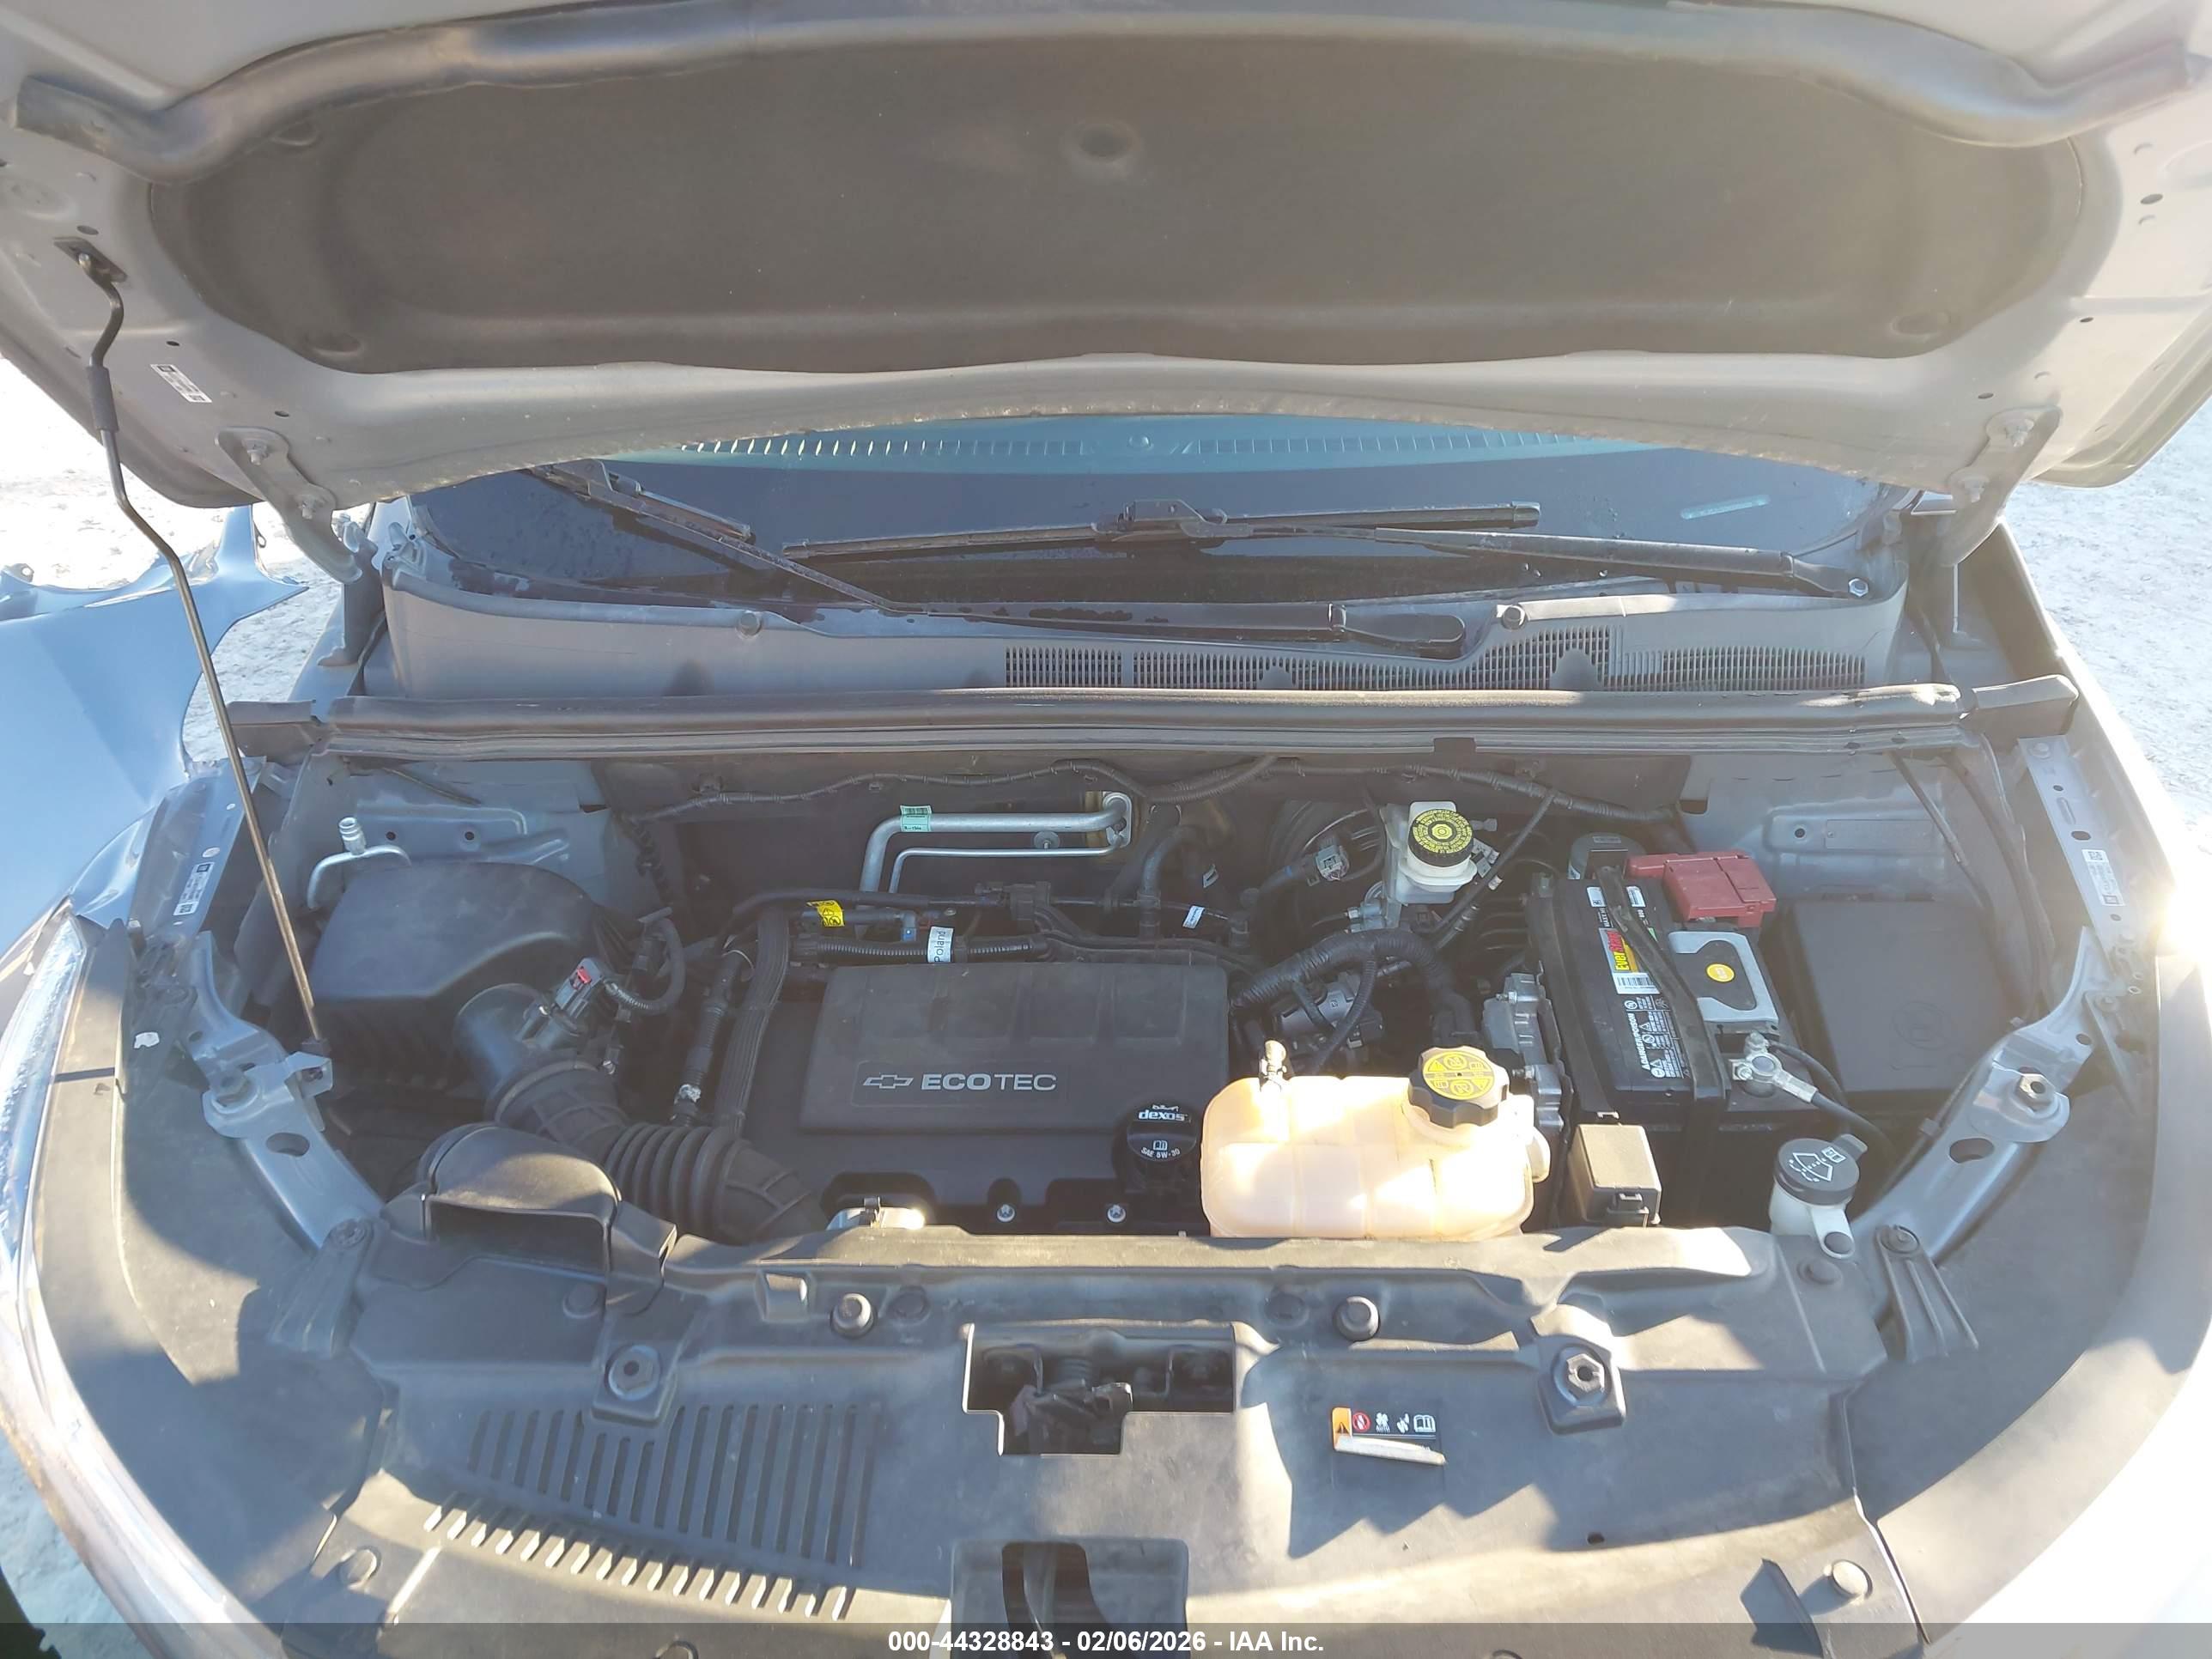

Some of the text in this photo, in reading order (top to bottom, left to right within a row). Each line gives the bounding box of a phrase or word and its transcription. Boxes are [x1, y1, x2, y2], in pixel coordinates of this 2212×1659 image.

[933, 931, 946, 963] Poland
[921, 1073, 1057, 1091] ECOTEC
[1138, 1109, 1185, 1121] dexos
[1140, 1146, 1155, 1158] SAE
